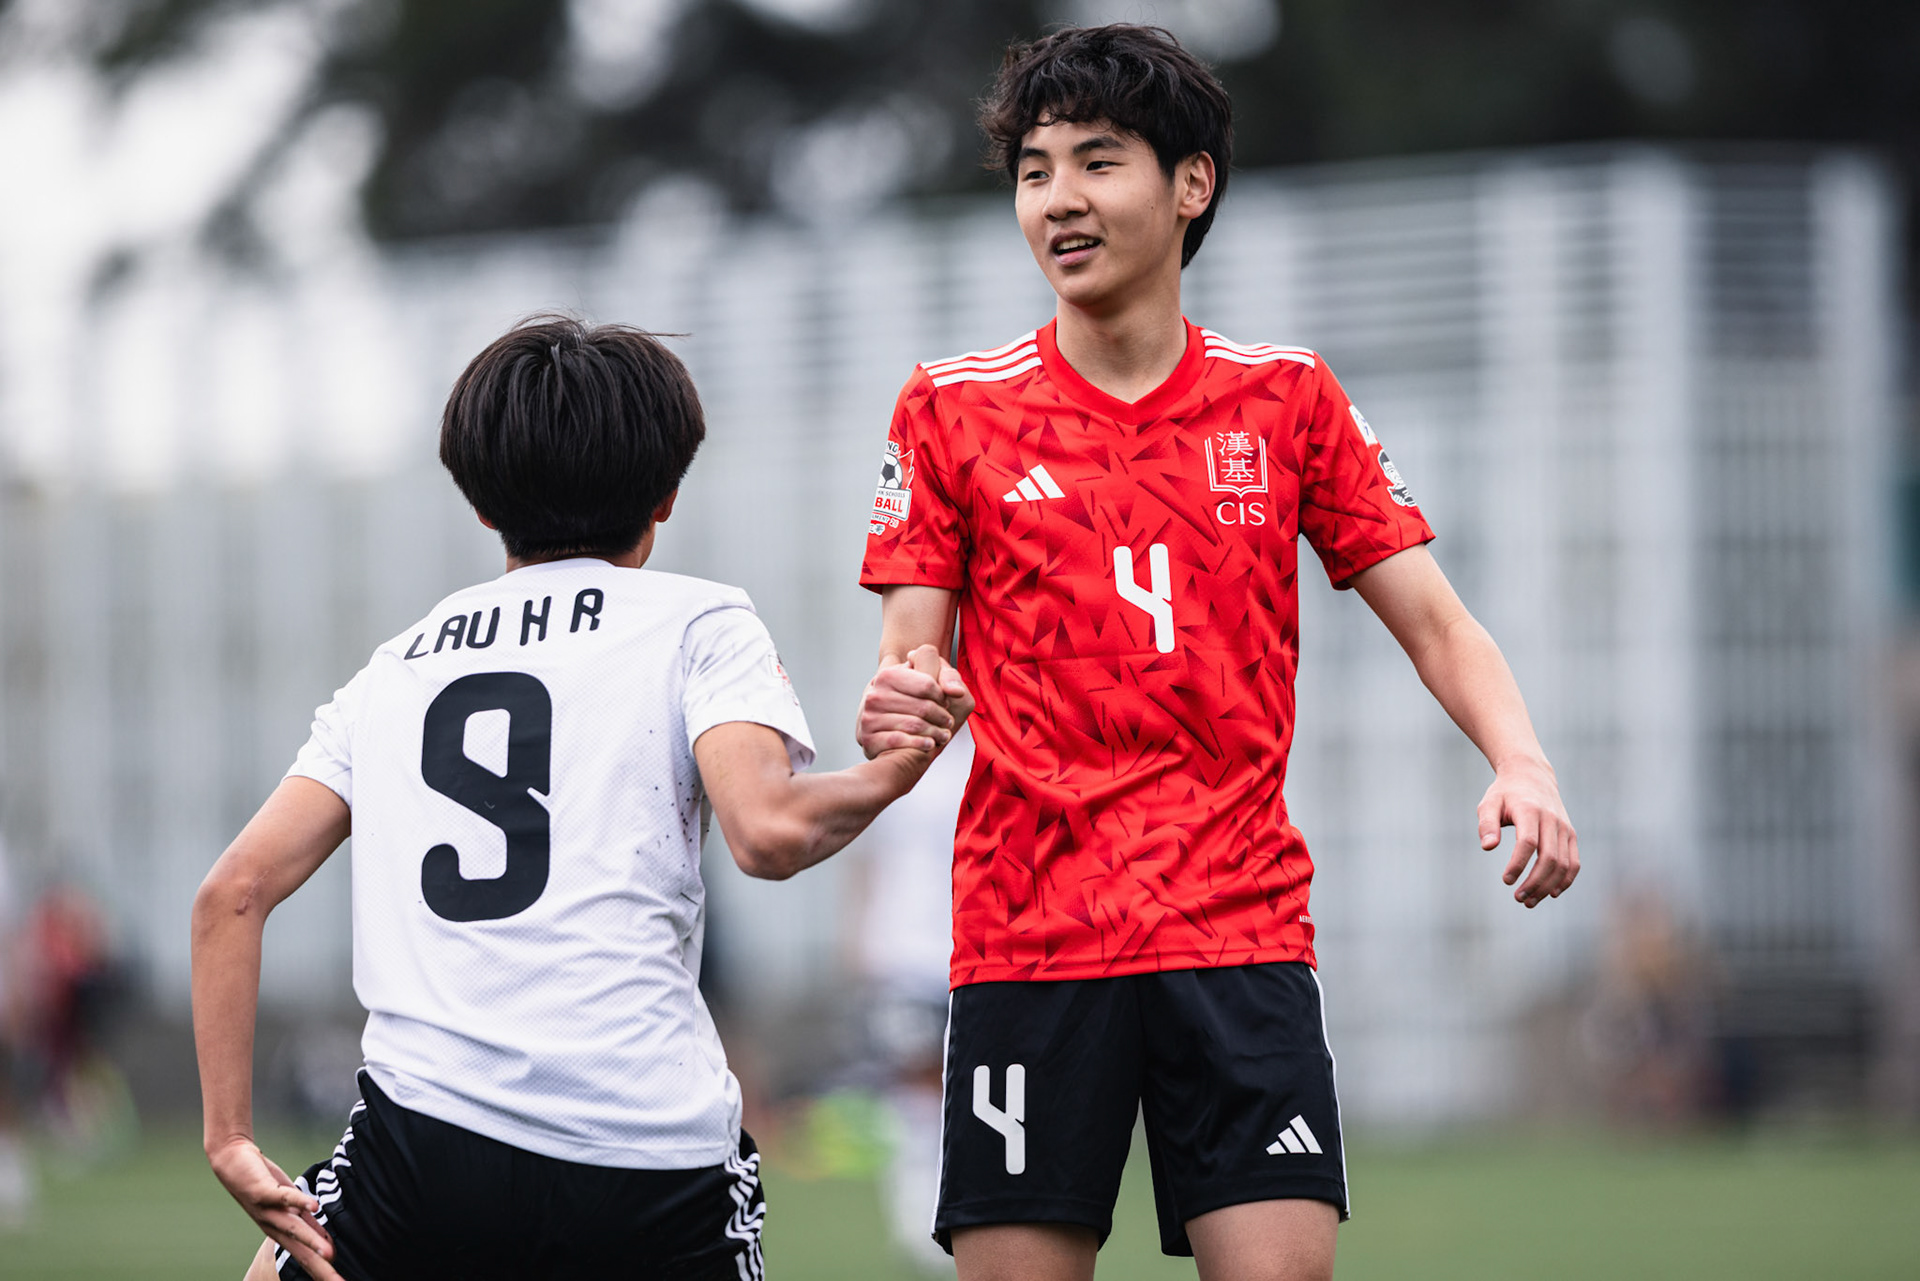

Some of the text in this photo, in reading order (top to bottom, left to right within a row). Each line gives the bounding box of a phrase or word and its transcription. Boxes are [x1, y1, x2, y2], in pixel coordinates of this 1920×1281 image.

[1216, 430, 1255, 483] 漢基
[874, 496, 904, 513] BALL
[1215, 501, 1266, 526] CIS
[404, 588, 604, 660] LAU H R
[1113, 543, 1175, 653] 4
[421, 672, 552, 923] 9
[972, 1063, 1026, 1175] 4
